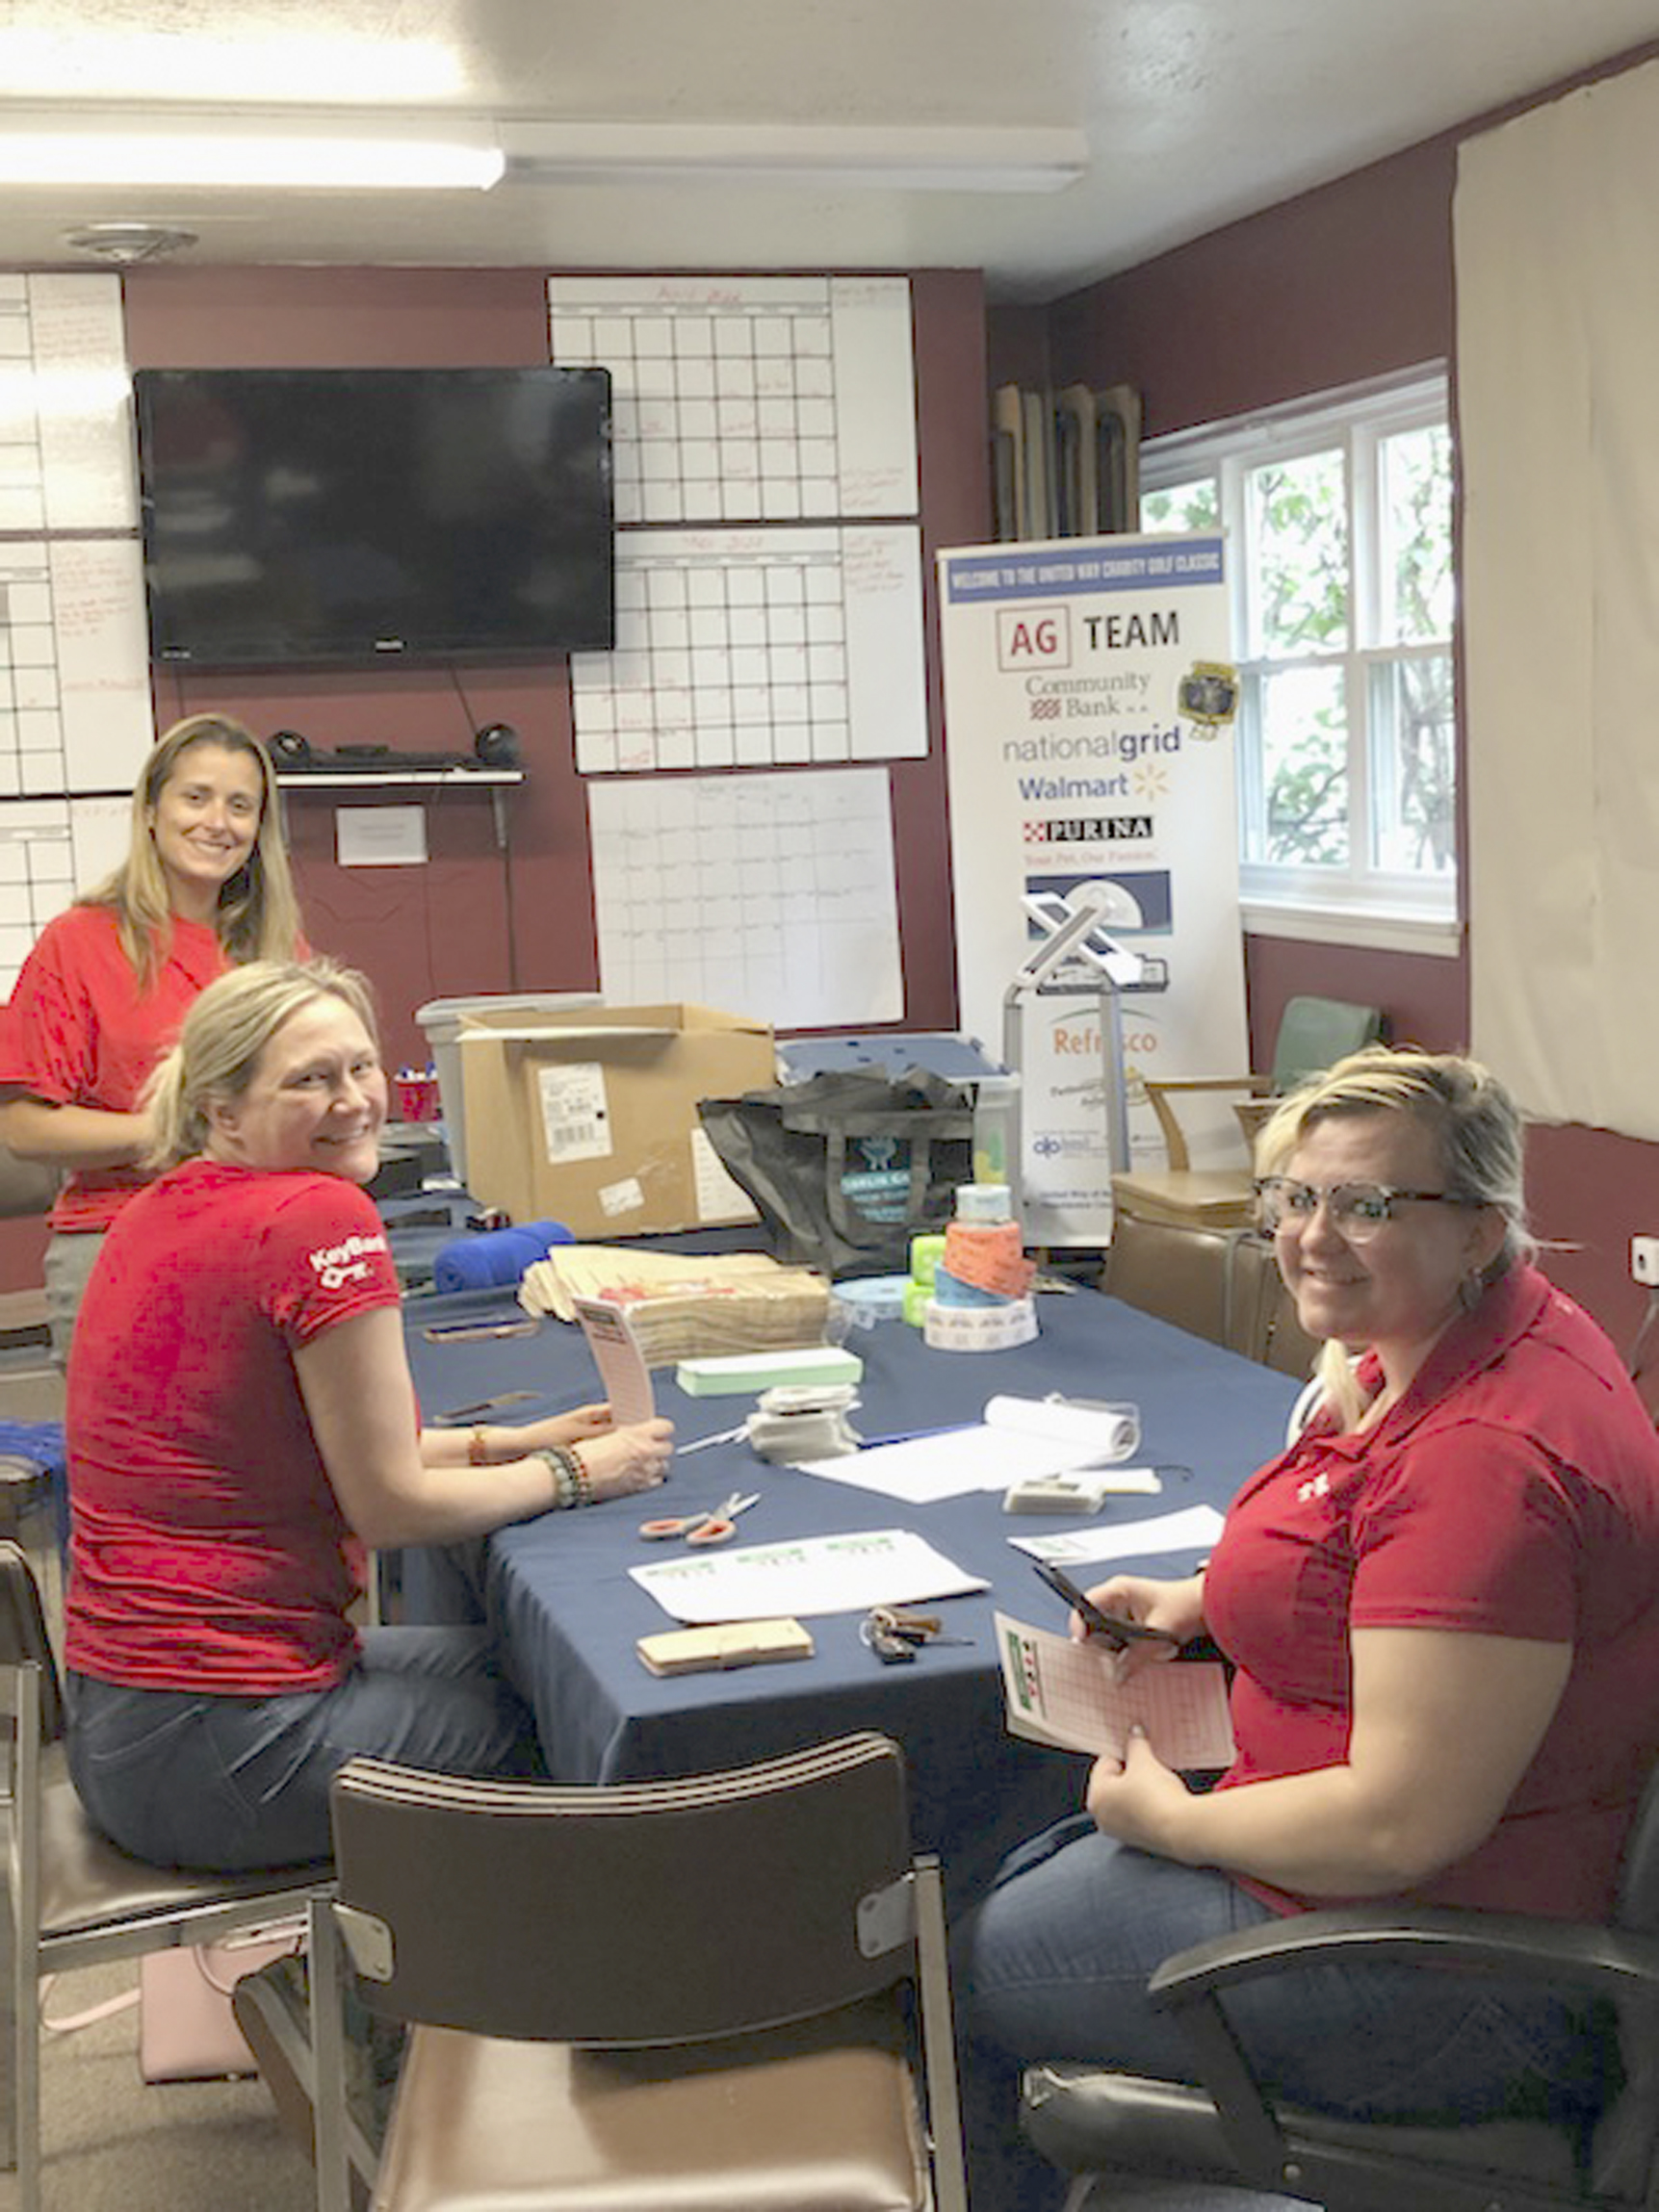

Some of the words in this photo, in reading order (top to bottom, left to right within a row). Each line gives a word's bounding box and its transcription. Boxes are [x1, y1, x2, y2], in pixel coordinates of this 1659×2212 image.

[952, 570, 999, 590] WELCOME
[1001, 568, 1016, 587] TO
[1017, 566, 1037, 585] THE
[1038, 563, 1075, 583] UNITED
[1076, 561, 1100, 580] WAY
[1102, 558, 1146, 579] CHARITY
[1148, 555, 1173, 575] GOLF
[1175, 553, 1220, 573] CLASSIC
[1010, 619, 1058, 656] AG
[1084, 611, 1179, 650] TEAM
[1025, 672, 1152, 697] Community
[1067, 694, 1121, 718] Bank
[1003, 724, 1180, 762] nationalgrid
[1019, 773, 1128, 800] Walmart
[1050, 818, 1151, 841] PURINA
[1054, 1026, 1157, 1055] Refrco
